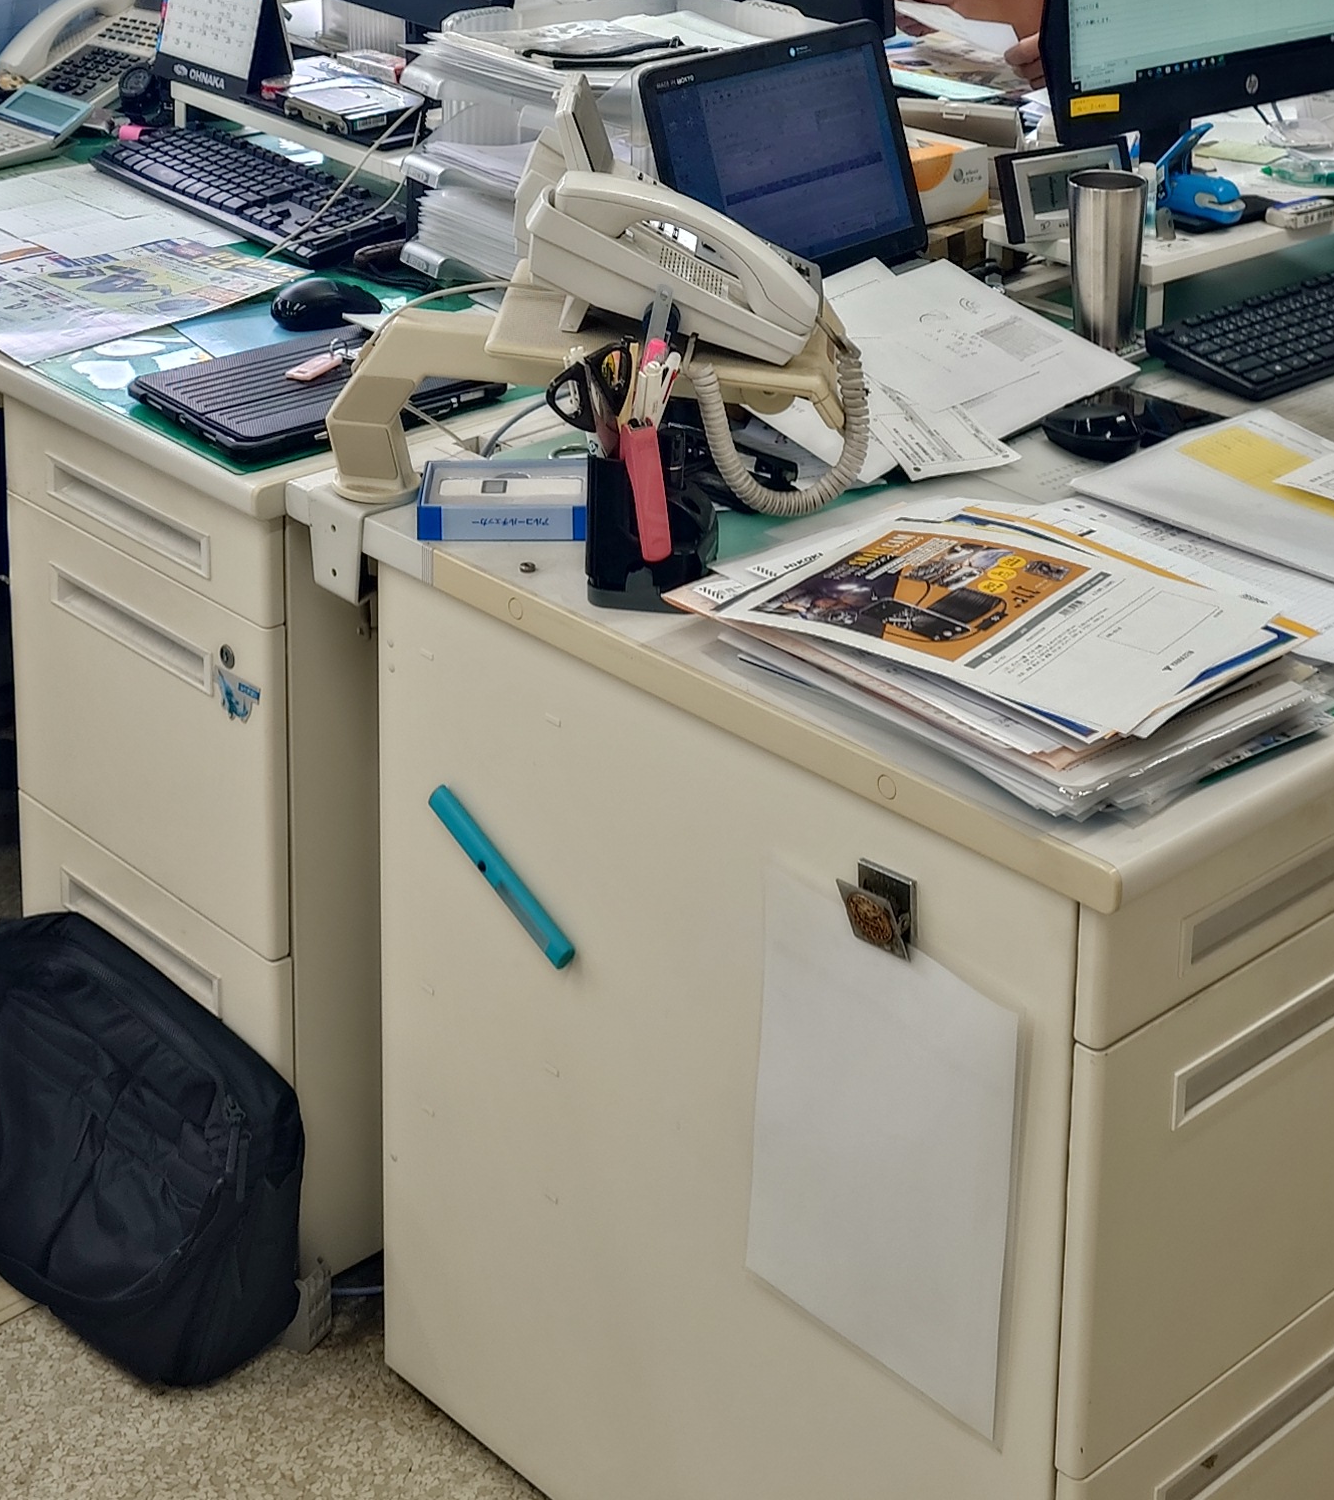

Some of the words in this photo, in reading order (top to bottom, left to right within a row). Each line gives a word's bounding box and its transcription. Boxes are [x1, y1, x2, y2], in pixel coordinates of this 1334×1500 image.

[188, 70, 226, 90] OHNAKA
[471, 517, 550, 527] アルコールチェッカー
